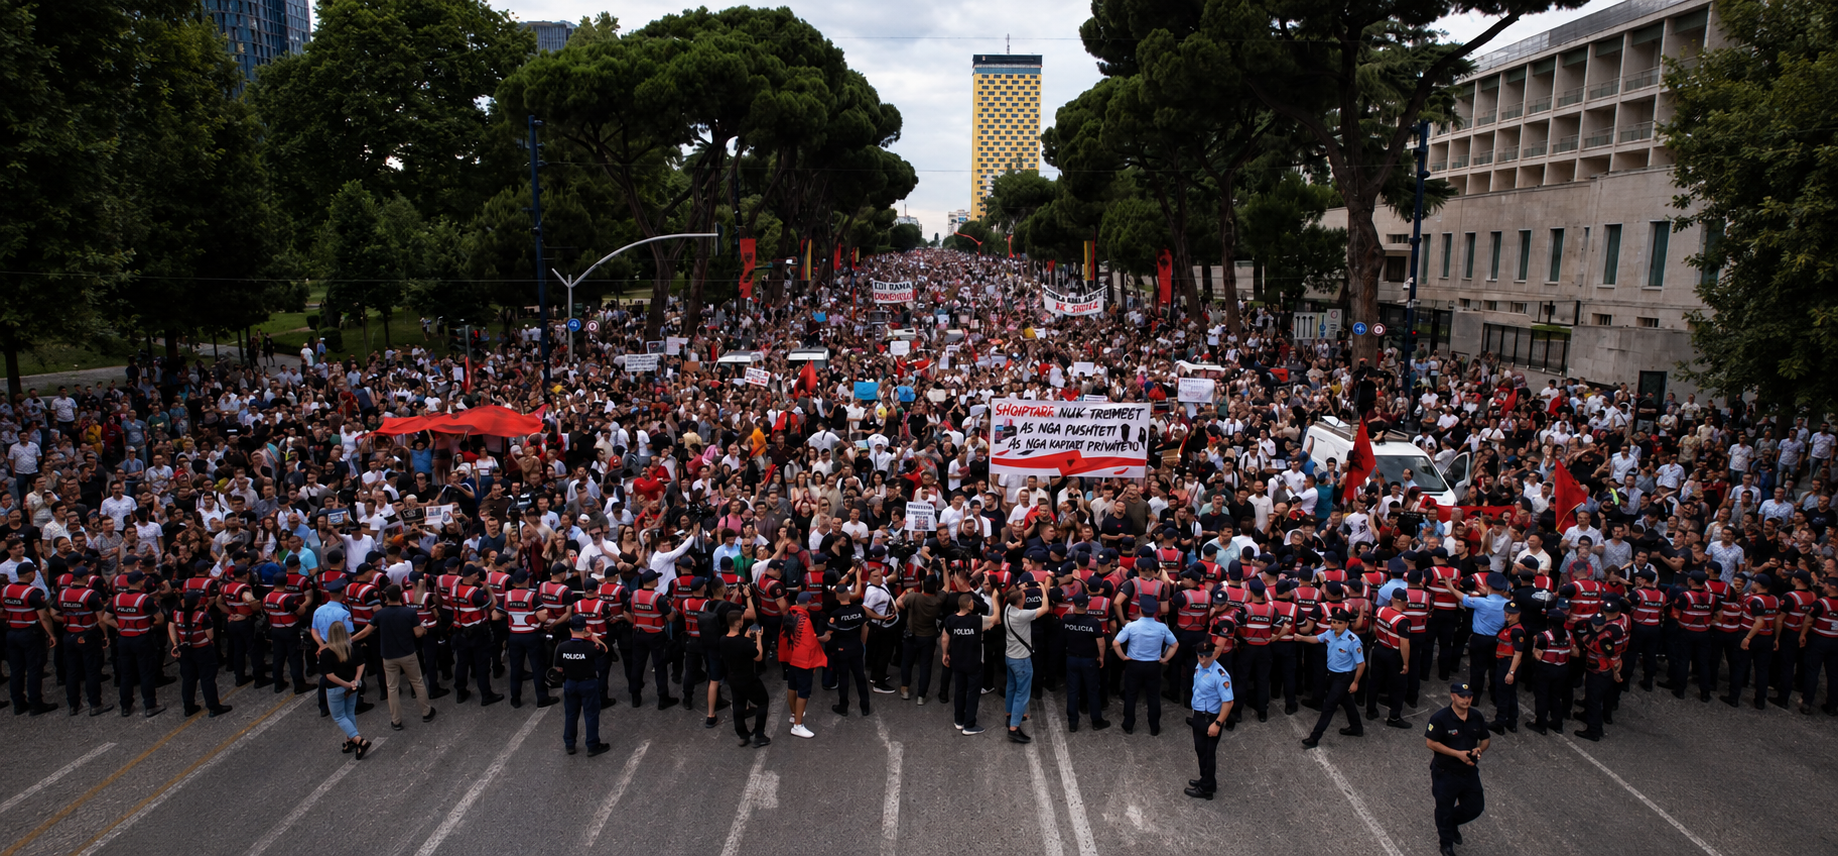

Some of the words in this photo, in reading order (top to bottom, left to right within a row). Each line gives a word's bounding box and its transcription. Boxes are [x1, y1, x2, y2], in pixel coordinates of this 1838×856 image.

[1059, 407, 1086, 418] NUK
[1020, 422, 1034, 434] AS
[1038, 422, 1061, 435] NGA
[1008, 437, 1021, 450] AS
[1026, 438, 1047, 450] NGA
[1064, 623, 1094, 633] POLICIA
